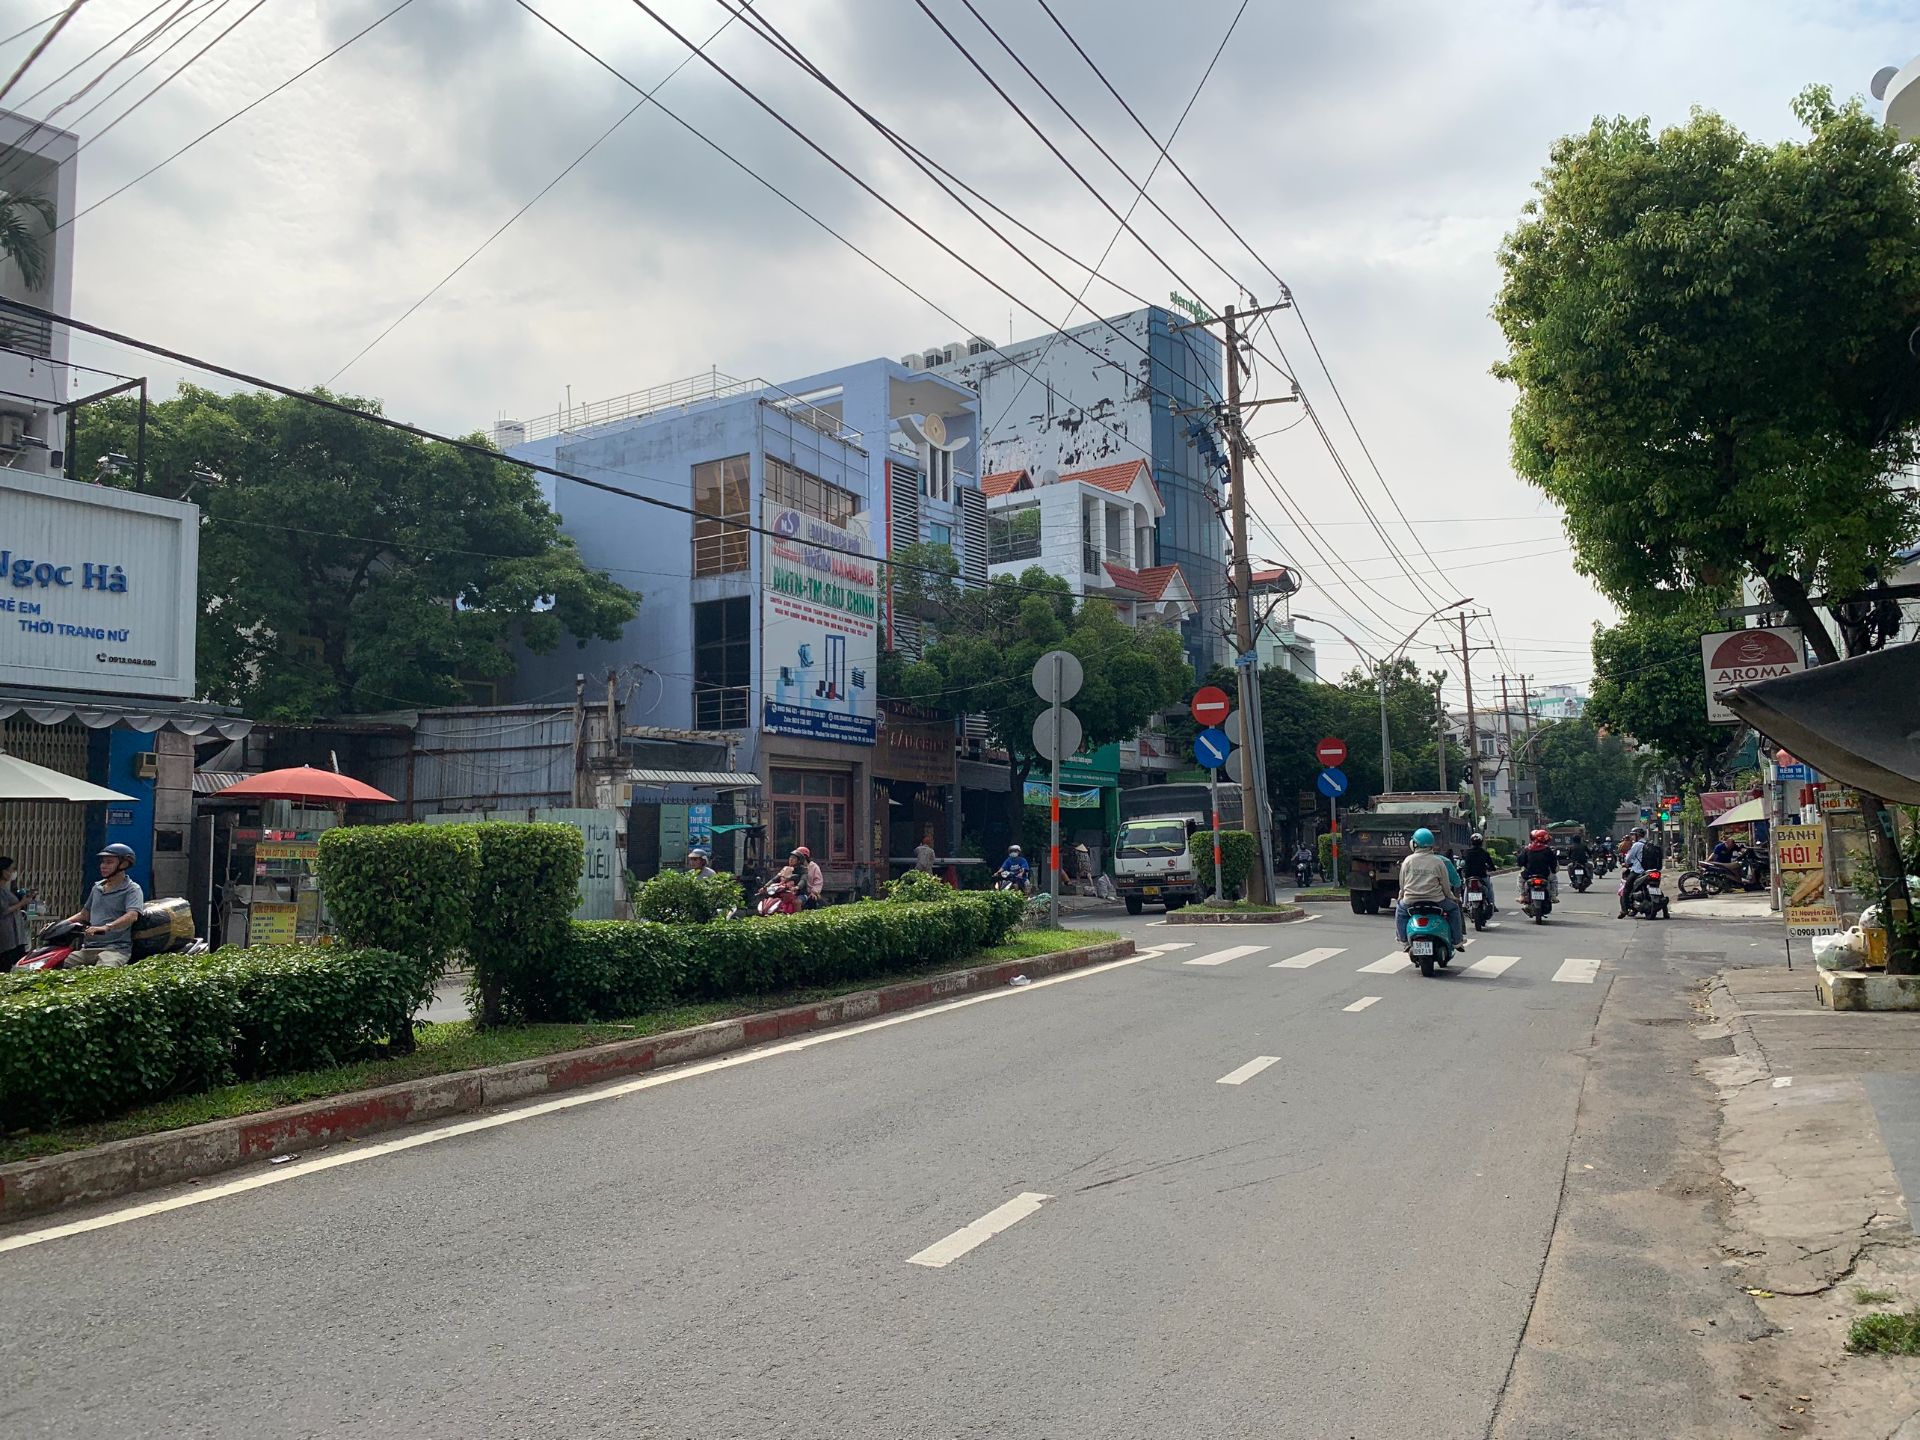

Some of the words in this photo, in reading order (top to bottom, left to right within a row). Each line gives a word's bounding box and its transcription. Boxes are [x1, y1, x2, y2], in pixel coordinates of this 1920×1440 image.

[19, 601, 41, 616] EM
[19, 618, 54, 634] THỜI
[57, 624, 105, 640] TRANG
[107, 628, 130, 643] NỮ
[1718, 665, 1791, 681] AROMA
[1382, 836, 1406, 846] 41156
[1777, 828, 1816, 841] BÁNH
[1869, 829, 1877, 842] 5
[1780, 842, 1810, 867] HỘI
[1797, 928, 1816, 937] 0908
[1818, 928, 1831, 937] 121
